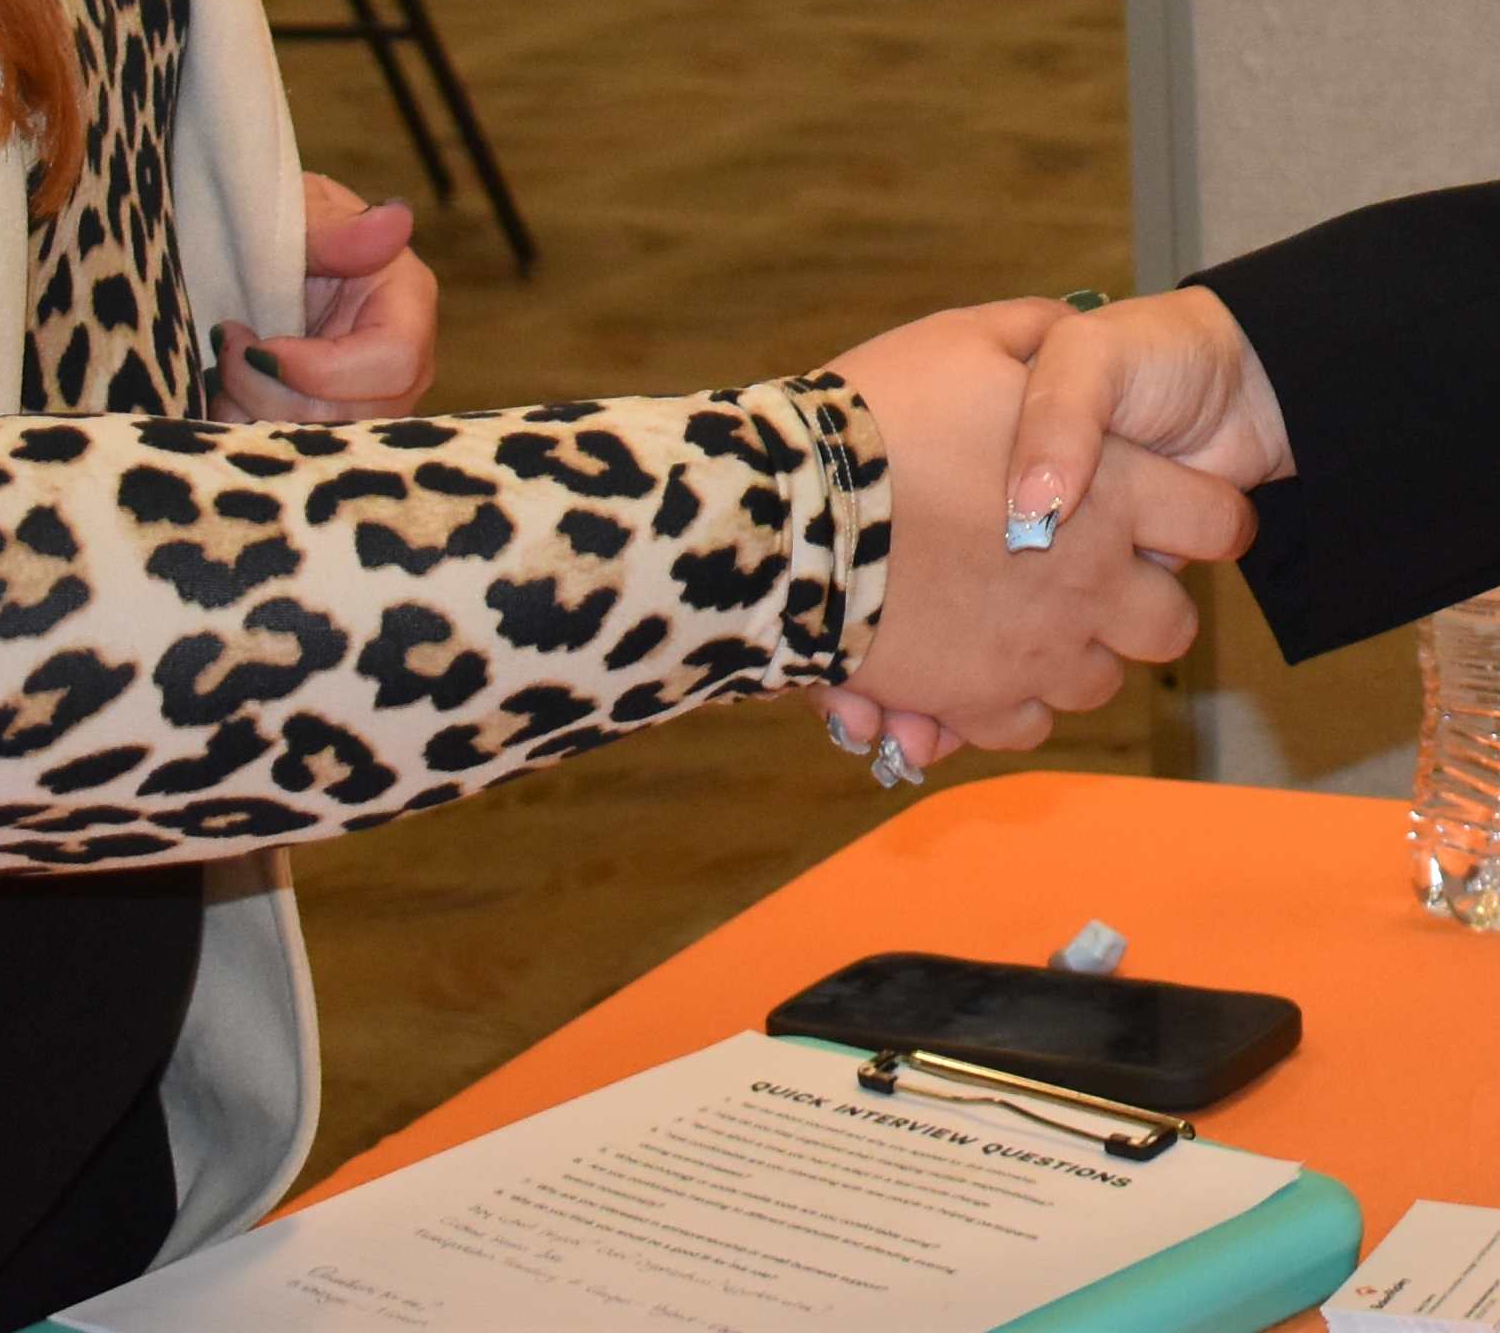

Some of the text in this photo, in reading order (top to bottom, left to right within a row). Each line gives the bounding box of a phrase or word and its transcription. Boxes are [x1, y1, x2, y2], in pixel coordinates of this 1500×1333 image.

[750, 1080, 831, 1109] QUICK
[833, 1103, 980, 1146] INTERVIEW
[981, 1141, 1133, 1189] QUESTIONS
